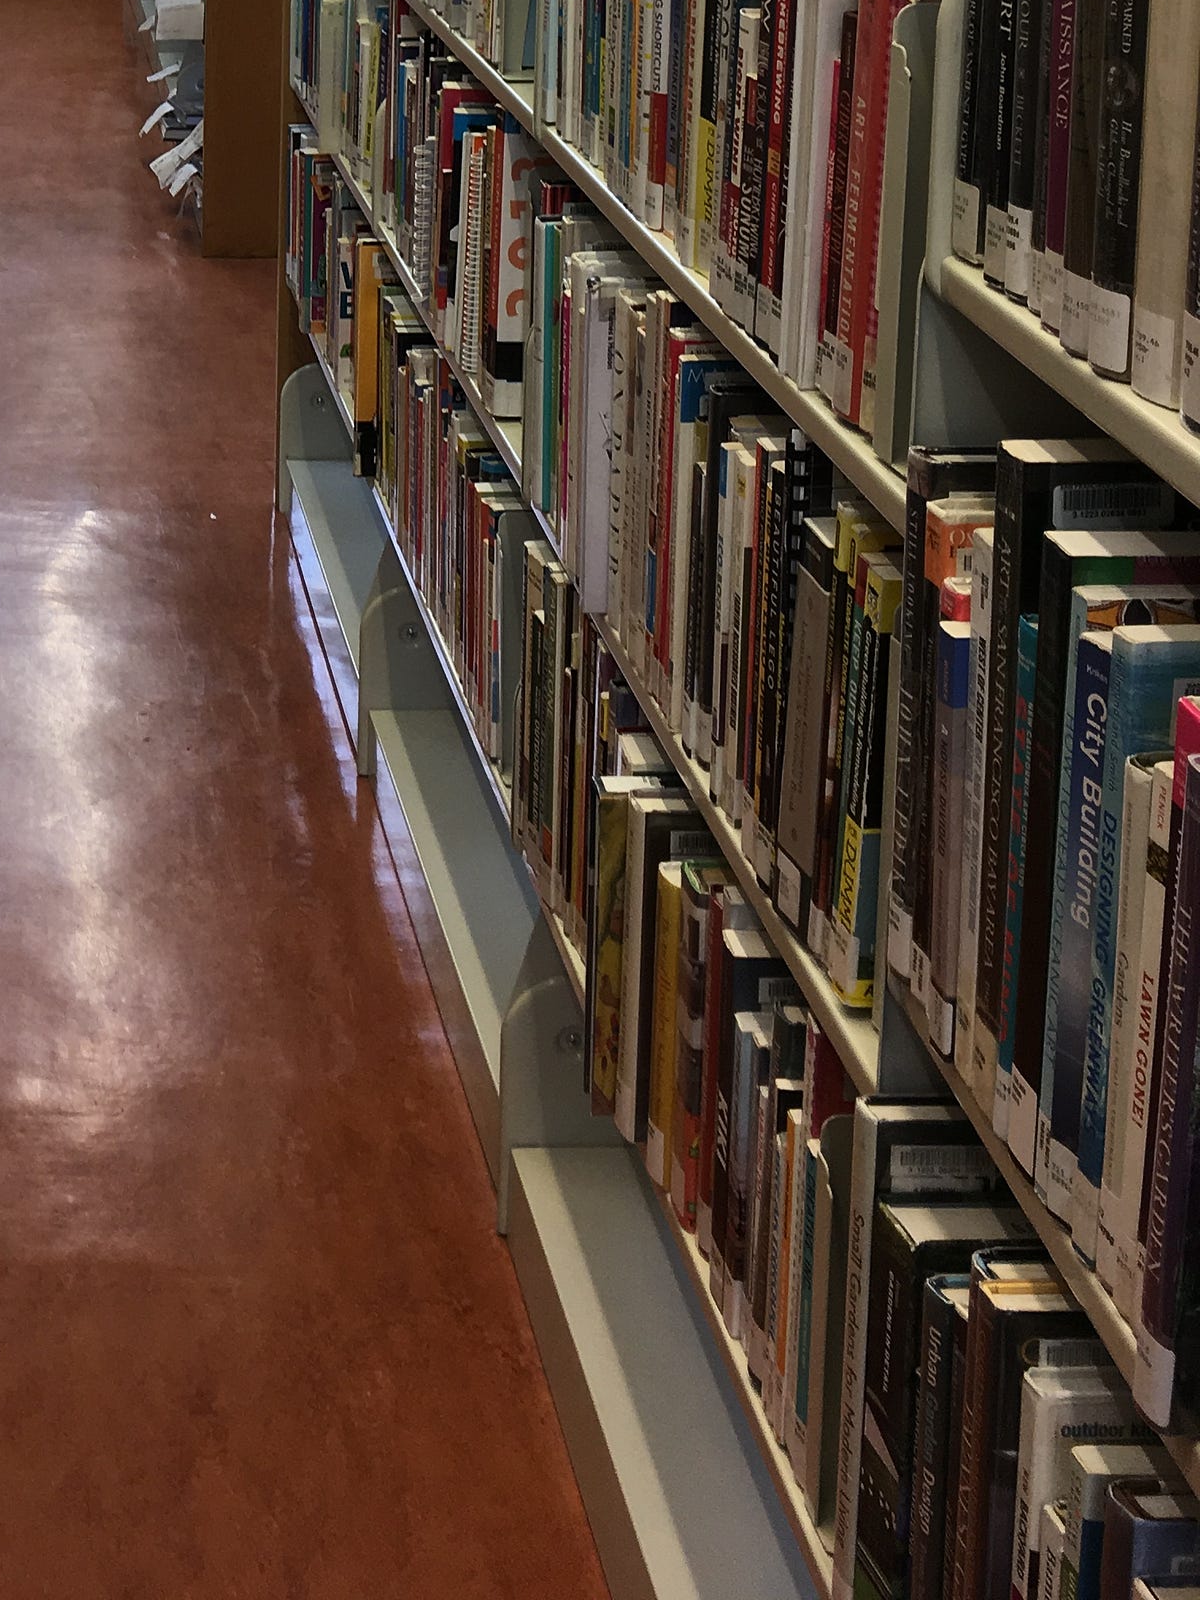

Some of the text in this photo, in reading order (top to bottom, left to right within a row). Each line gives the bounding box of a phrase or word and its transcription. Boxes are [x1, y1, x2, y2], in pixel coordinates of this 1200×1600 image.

[653, 12, 663, 92] SHORTCUTS
[711, 55, 720, 120] Marketing
[841, 95, 865, 346] ART FERMENTATION
[767, 492, 781, 690] BEAUTIFUL LEGO
[997, 536, 1011, 590] ART
[836, 592, 852, 768] COMPLETE WINDOWS
[848, 617, 862, 726] KEEP OUT!
[996, 624, 1007, 680] SAN
[850, 630, 871, 817] Green Building Remodeling
[897, 685, 913, 770] JOHN
[976, 691, 985, 743] CENTER
[1061, 712, 1074, 780] HOW
[990, 682, 1004, 841] FRANCISCO
[1071, 692, 1107, 929] City Building
[1156, 784, 1166, 829] PENICK
[1057, 824, 1068, 892] READ
[984, 890, 994, 970] AREA
[1049, 899, 1063, 1010] OCEANIC
[1176, 904, 1192, 970] THE
[1085, 810, 1117, 1137] DESIGNING GREENWAYS
[1115, 951, 1129, 1027] Gardens
[1046, 1014, 1056, 1070] ART
[1132, 971, 1153, 1129] LAWN GONE!
[1147, 1145, 1170, 1278] GARDEN
[838, 1209, 864, 1550] Small Gardens for Modern Living
[920, 1325, 942, 1535] Urban Garden Design
[1060, 1420, 1125, 1440] outdoor
[1016, 1498, 1028, 1580] BACKYARD
